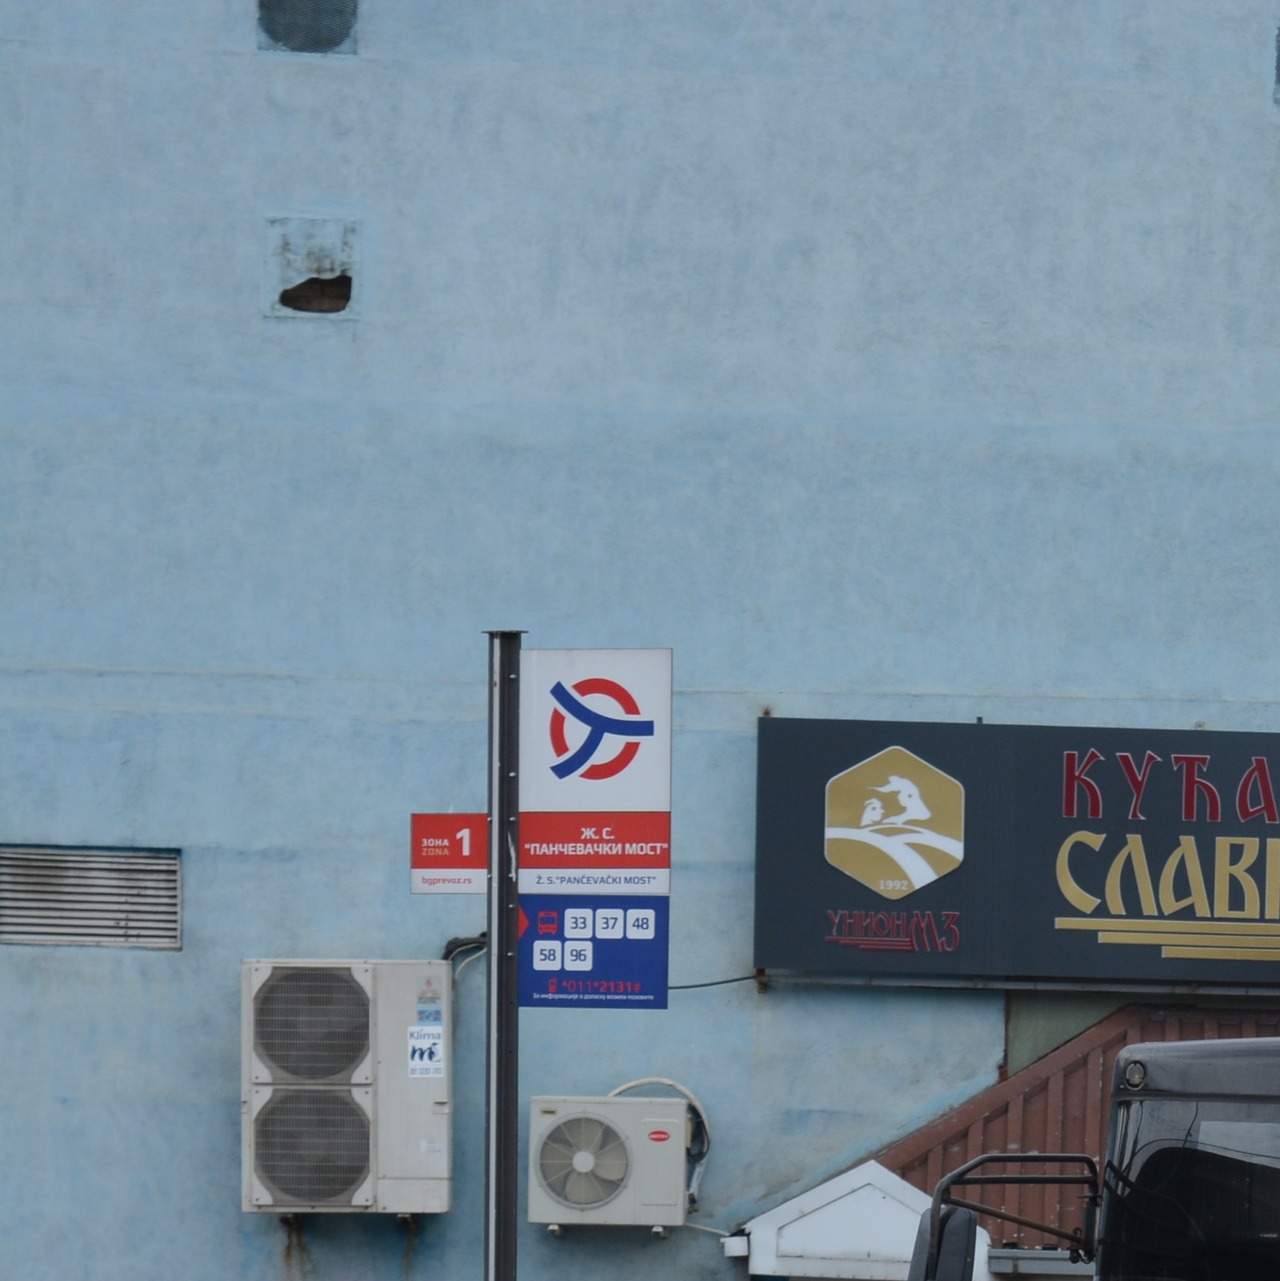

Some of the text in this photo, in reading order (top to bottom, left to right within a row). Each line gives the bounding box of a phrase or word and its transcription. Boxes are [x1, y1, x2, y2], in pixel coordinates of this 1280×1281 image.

[1061, 748, 1280, 825] КУЋА
[580, 827, 616, 839] Ж. С.
[421, 838, 449, 847] ЗОНА
[455, 828, 470, 856] 1
[421, 848, 449, 856] ZONA
[421, 876, 472, 886] bgprevoz.rs
[879, 880, 909, 890] 1992
[570, 916, 650, 930] 33 37 48
[538, 948, 587, 962] 58 96
